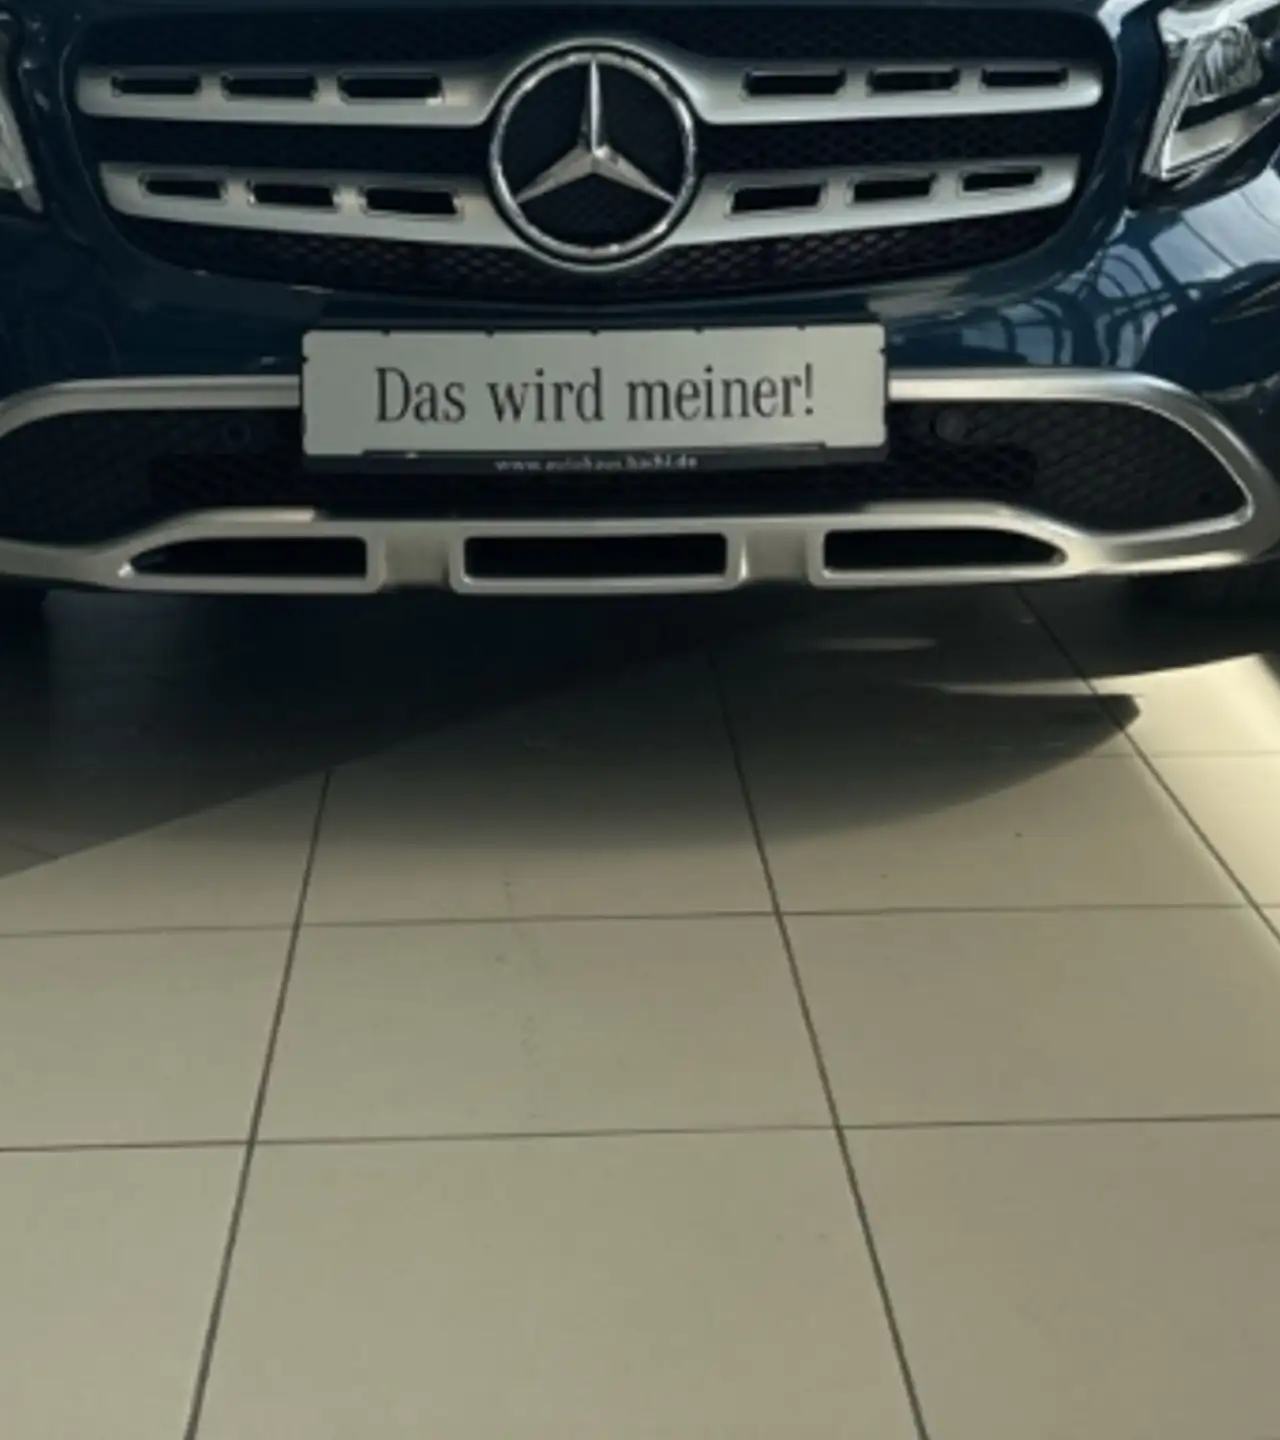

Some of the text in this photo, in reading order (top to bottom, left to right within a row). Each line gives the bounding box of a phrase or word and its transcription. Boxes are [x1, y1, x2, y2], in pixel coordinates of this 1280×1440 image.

[374, 362, 815, 423] Das wird meiner!
